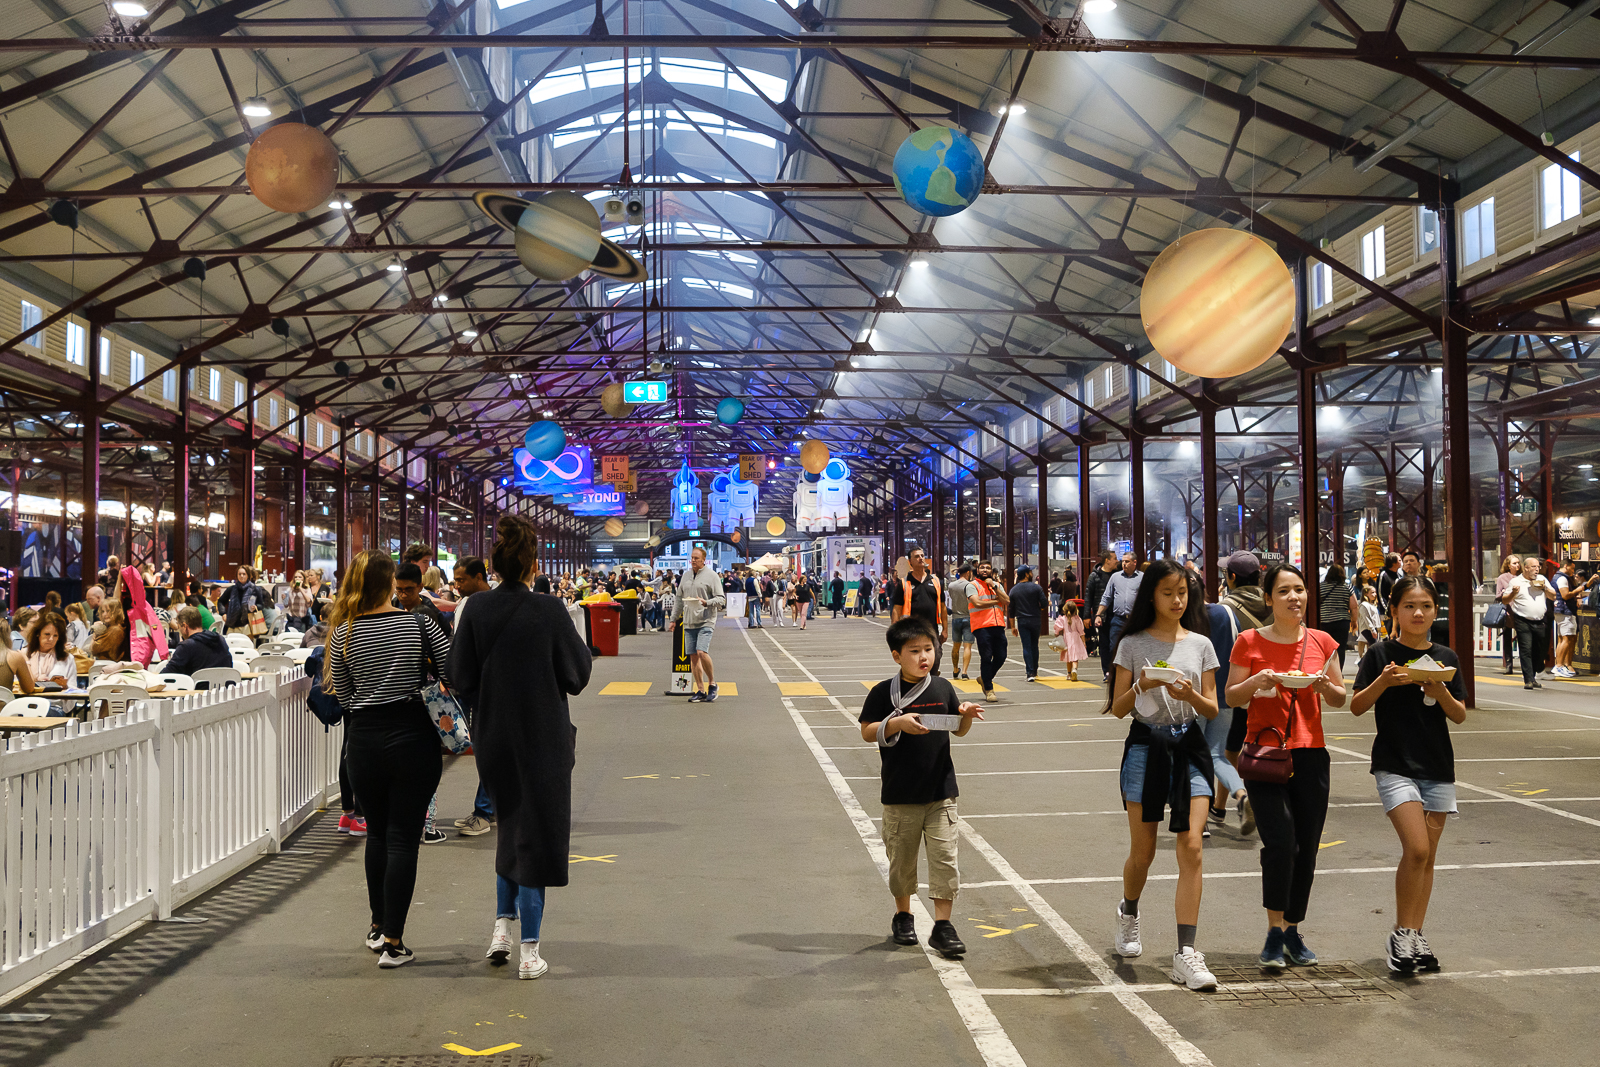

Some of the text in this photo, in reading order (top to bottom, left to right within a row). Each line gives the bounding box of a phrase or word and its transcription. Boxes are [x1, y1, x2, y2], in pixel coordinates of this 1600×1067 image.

[611, 463, 619, 471] L
[748, 462, 756, 470] K
[675, 664, 690, 672] APART
